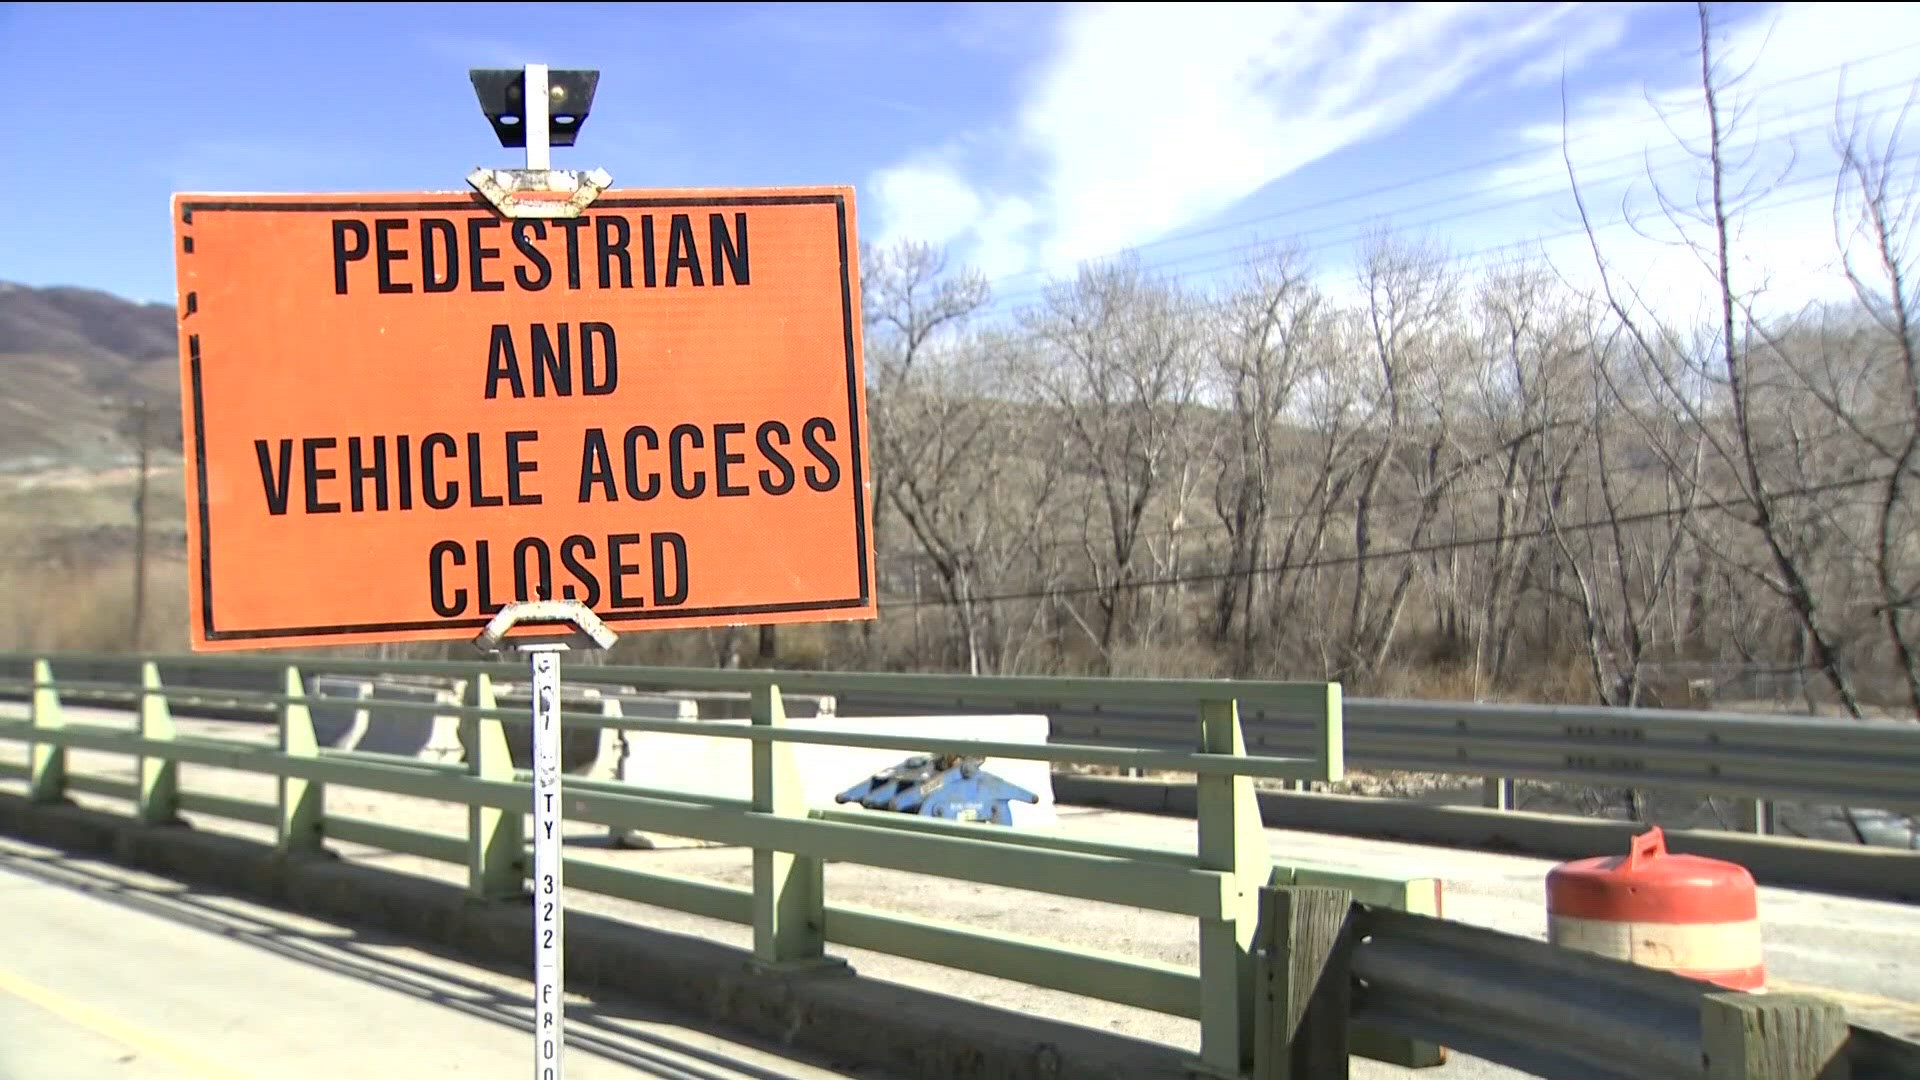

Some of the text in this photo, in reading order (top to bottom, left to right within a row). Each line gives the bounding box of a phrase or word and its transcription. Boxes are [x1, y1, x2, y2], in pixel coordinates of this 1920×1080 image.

[333, 212, 750, 295] PEDESTRIAN
[485, 322, 618, 399] AND
[255, 416, 841, 515] VEHICLE ACCESS
[429, 532, 689, 618] CLOSED
